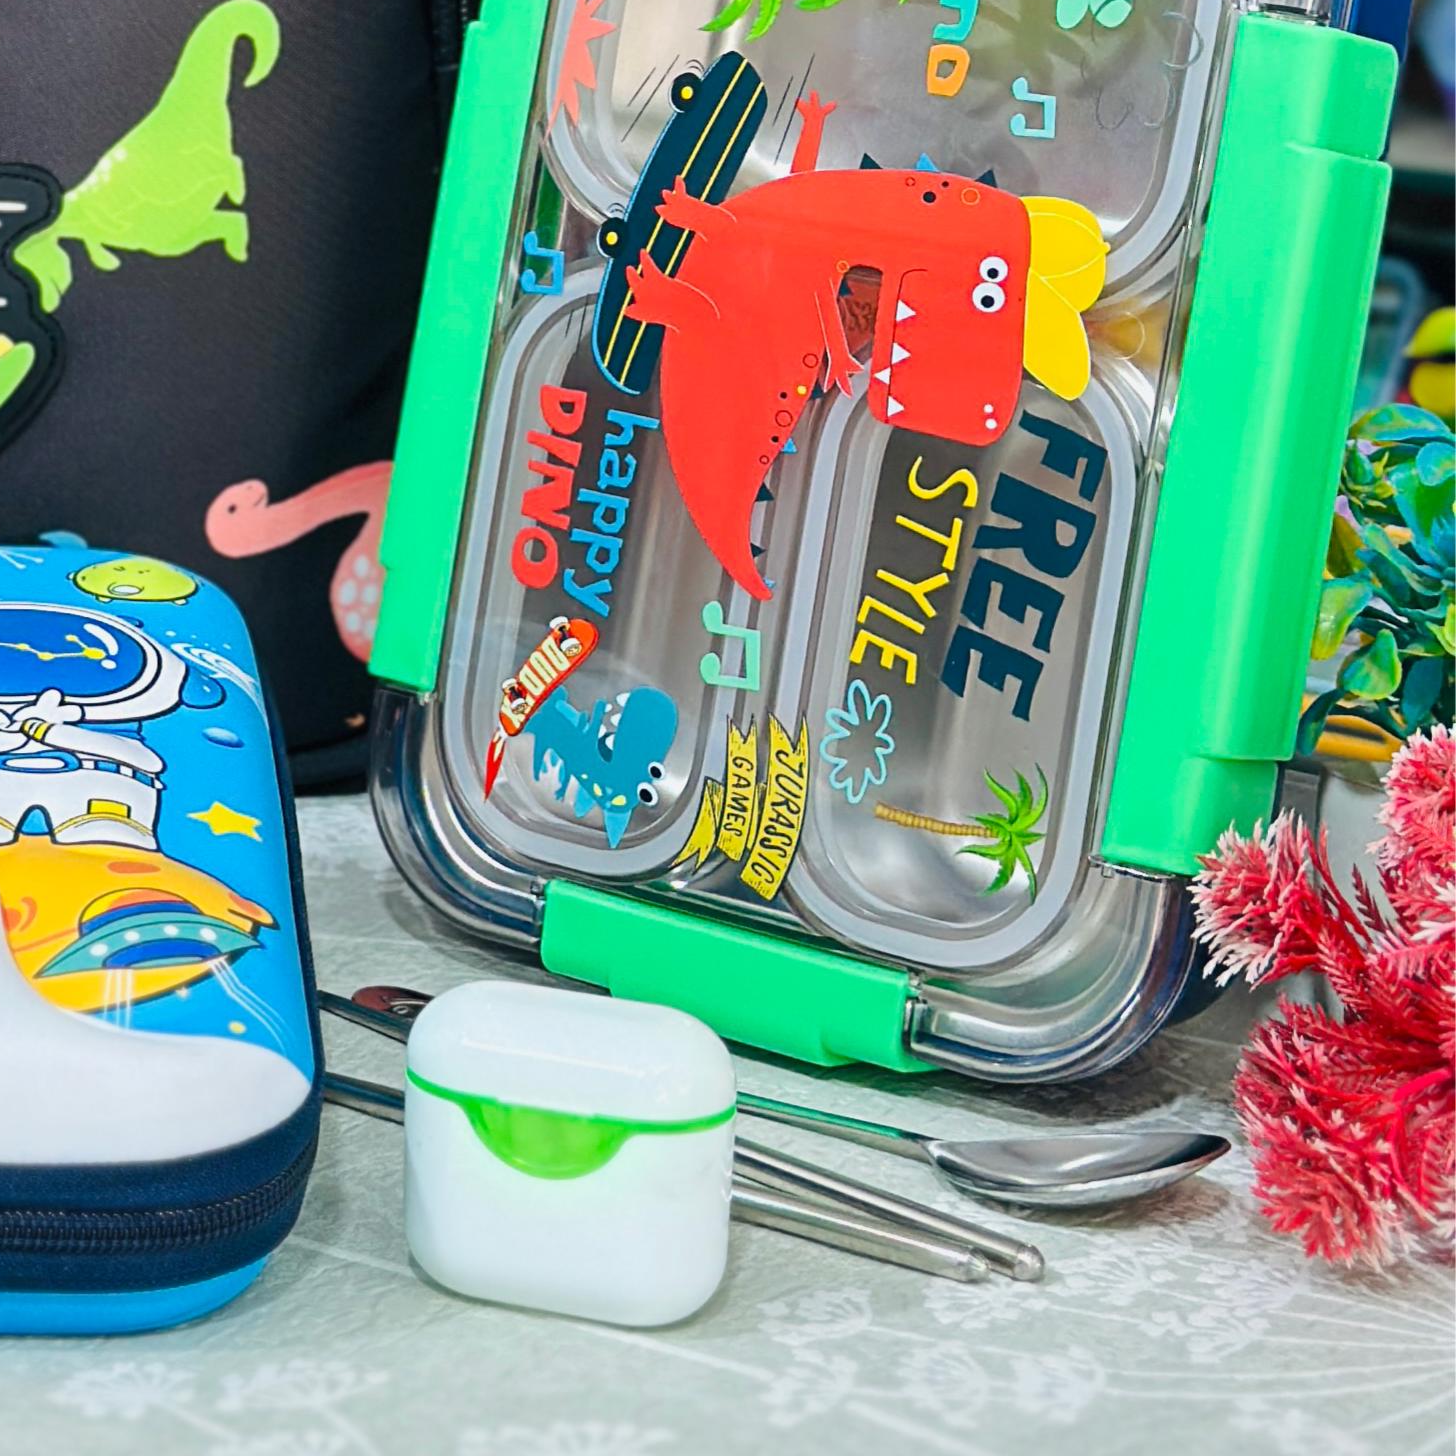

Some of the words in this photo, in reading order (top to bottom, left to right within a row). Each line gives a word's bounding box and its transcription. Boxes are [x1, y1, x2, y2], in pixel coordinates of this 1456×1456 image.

[510, 384, 587, 589] DINO
[564, 409, 660, 617] happy
[848, 456, 979, 685] STYLE
[940, 408, 1108, 722] FREE
[723, 756, 754, 837] GAMES
[750, 749, 804, 885] JURASSIC
